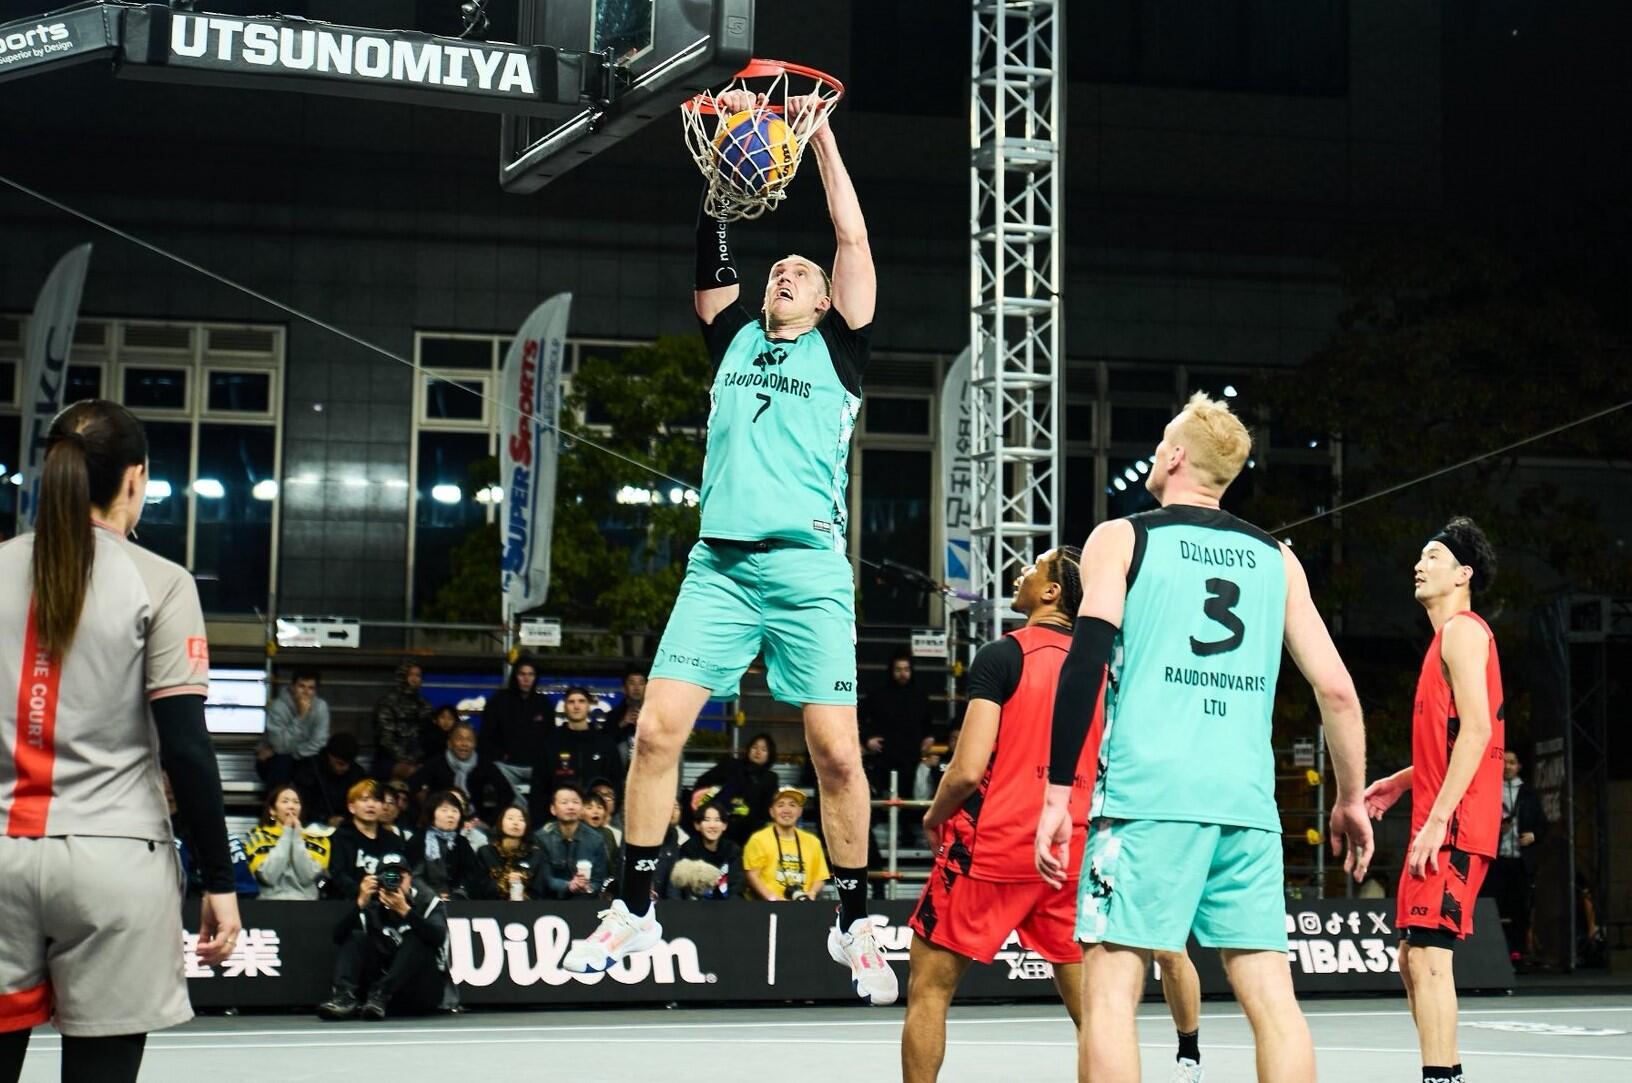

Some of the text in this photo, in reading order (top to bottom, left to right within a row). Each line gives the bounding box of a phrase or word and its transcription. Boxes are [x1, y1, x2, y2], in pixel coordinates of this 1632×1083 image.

[32, 48, 44, 57] by
[44, 41, 73, 53] Design
[171, 15, 534, 93] UTSUNOMIYA
[752, 392, 771, 423] 7
[502, 338, 539, 575] SUPER SPORTS
[1180, 540, 1257, 569] DZIAUGYS
[1189, 577, 1246, 657] 3
[1165, 666, 1267, 692] RAUDONDVARIS
[27, 683, 47, 749] COURT
[1204, 698, 1227, 716] LTU
